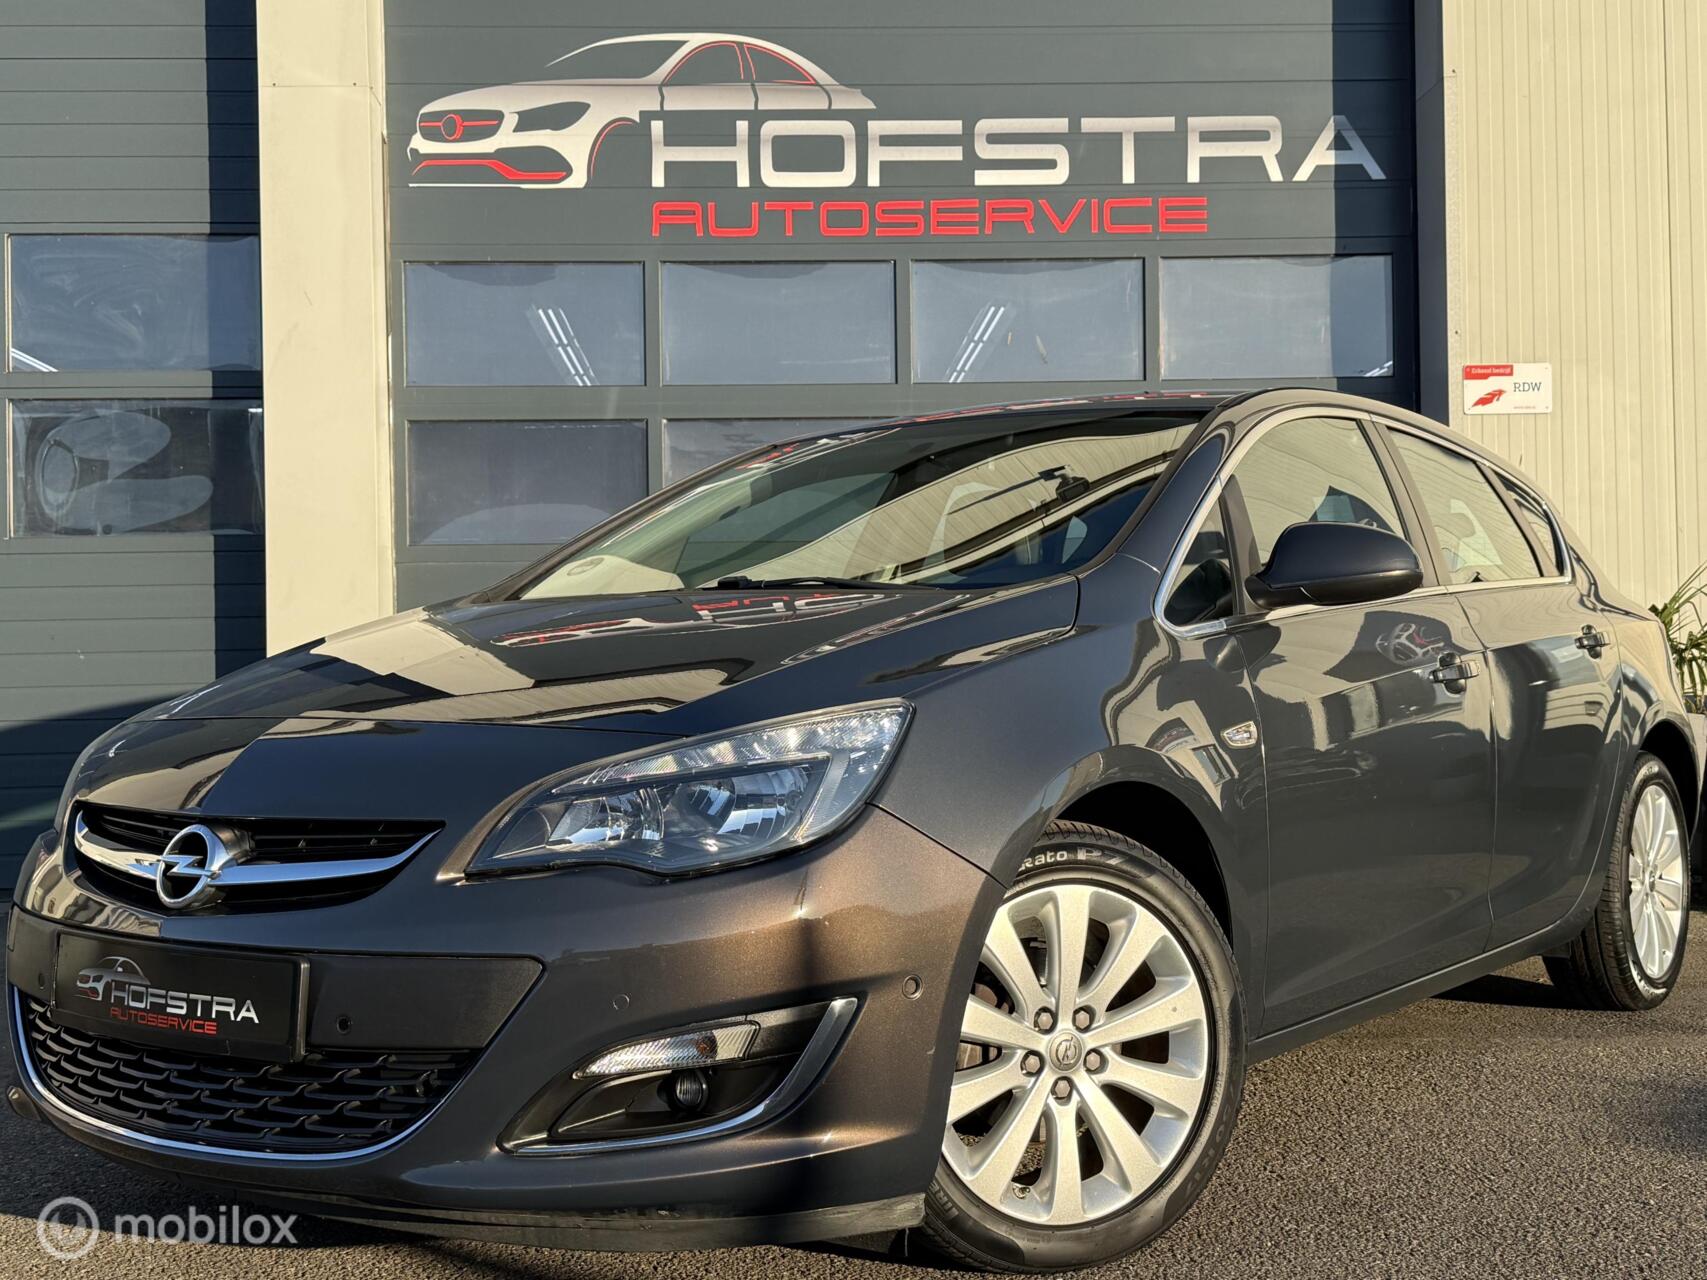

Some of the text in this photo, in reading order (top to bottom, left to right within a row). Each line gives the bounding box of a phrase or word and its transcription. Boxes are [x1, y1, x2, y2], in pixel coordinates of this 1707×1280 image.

[650, 114, 1387, 189] HOFSTRA
[650, 197, 1208, 237] AUTOSERVICE
[1513, 382, 1542, 393] RDW
[109, 1007, 218, 1035] AUTOSERVICE
[110, 980, 260, 1024] HOFSTRA
